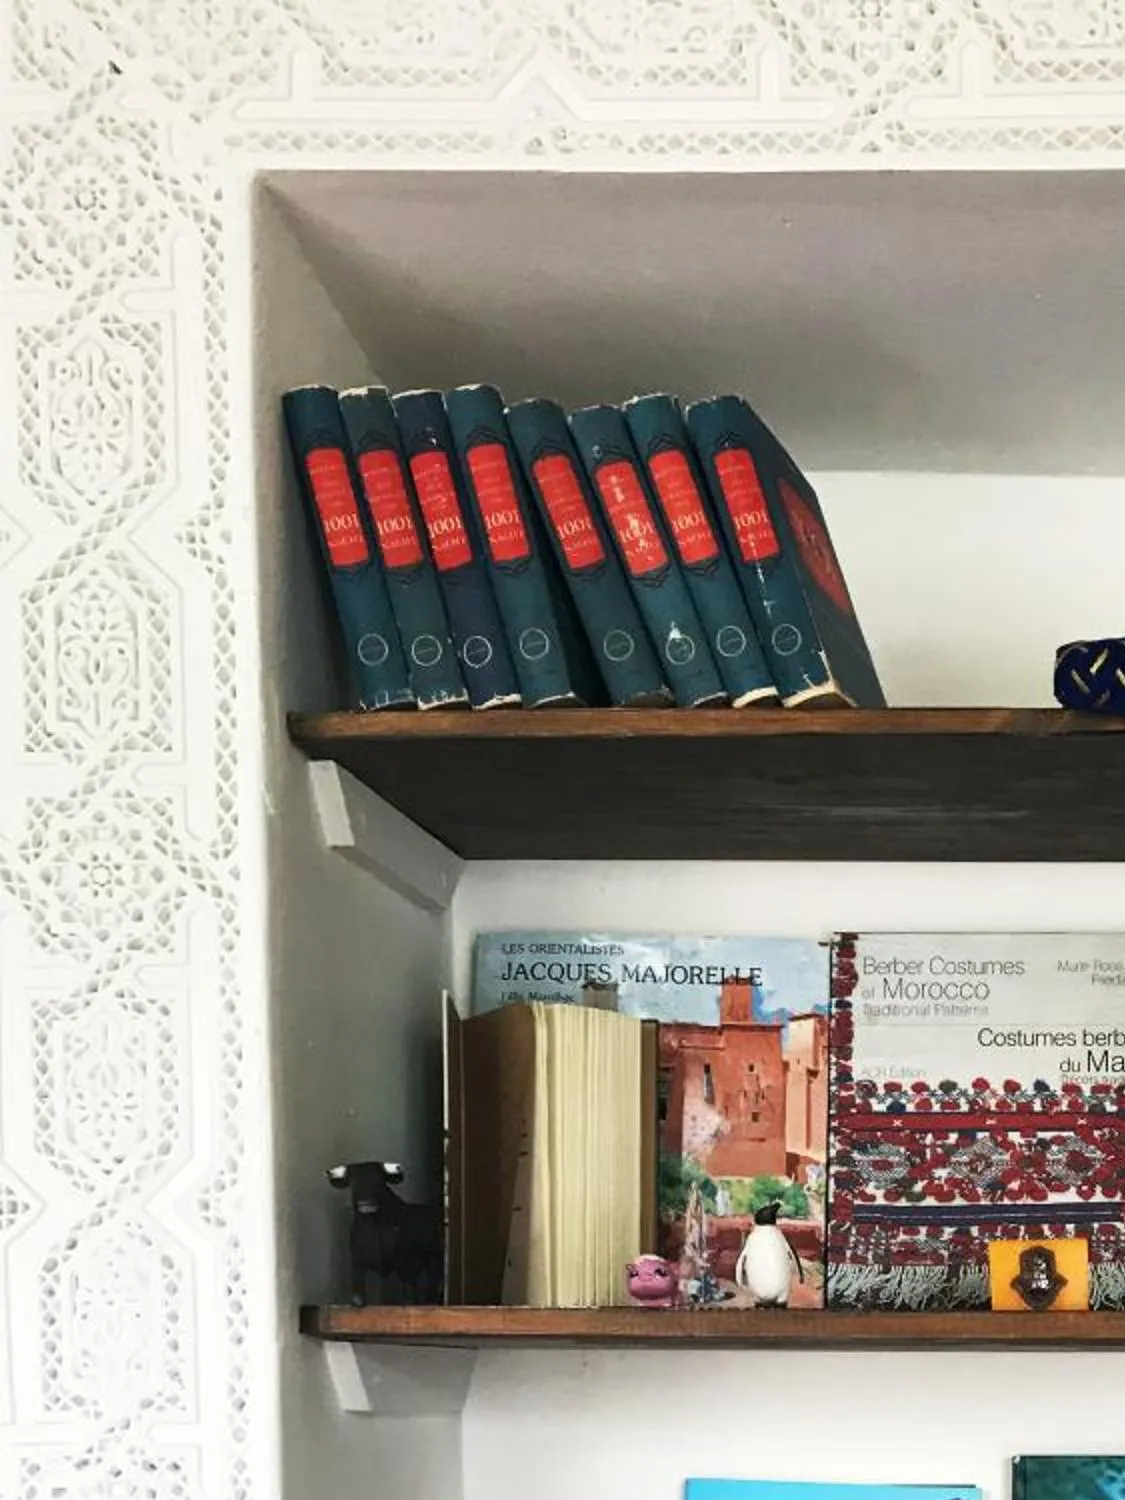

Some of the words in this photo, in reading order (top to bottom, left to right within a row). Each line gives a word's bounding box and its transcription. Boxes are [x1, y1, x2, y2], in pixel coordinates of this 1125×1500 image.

[323, 513, 359, 532] 1001
[376, 515, 414, 536] 1001
[428, 515, 463, 538] 1001
[485, 511, 520, 529] 1001
[557, 516, 593, 539] 1001
[672, 511, 707, 533] 1001
[734, 511, 769, 531] 1001
[501, 944, 525, 955] LES
[529, 944, 625, 956] ORIENTALISTES
[501, 961, 612, 984] JACQUES
[621, 963, 763, 987] MAJORELLE
[862, 955, 926, 977] Berber
[929, 955, 1025, 977] Costumes
[861, 987, 876, 1000] of
[883, 978, 991, 1001] Morocco
[862, 1003, 931, 1018] Traditional
[977, 1027, 1077, 1048] Costumes
[1059, 1056, 1081, 1073] du
